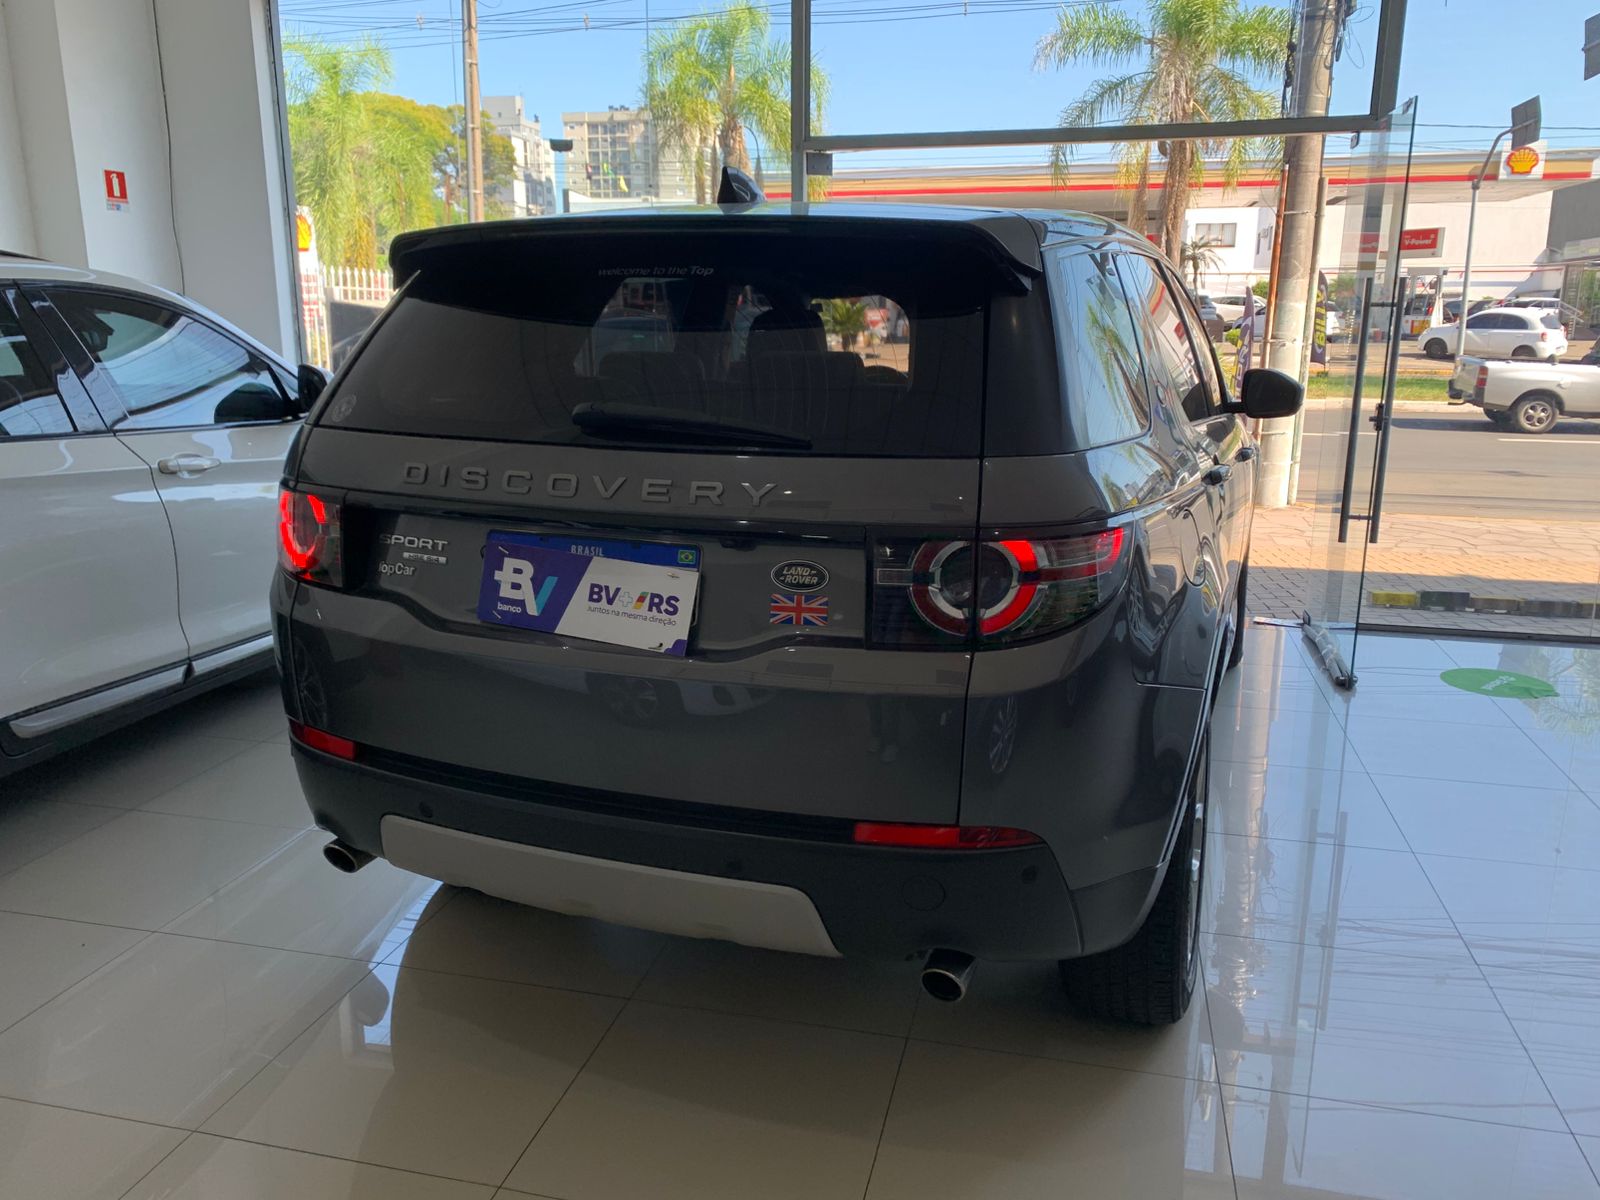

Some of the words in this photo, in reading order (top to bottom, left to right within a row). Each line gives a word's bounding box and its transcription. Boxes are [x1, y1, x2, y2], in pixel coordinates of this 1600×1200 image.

[653, 266, 666, 276] to
[667, 266, 688, 276] the
[690, 265, 714, 277] Top
[403, 461, 778, 506] DISCOVERY
[379, 534, 449, 551] SPORT
[570, 544, 605, 557] BRASIL
[497, 602, 522, 613] banco
[621, 612, 648, 622] mesma
[648, 614, 677, 627] direção
